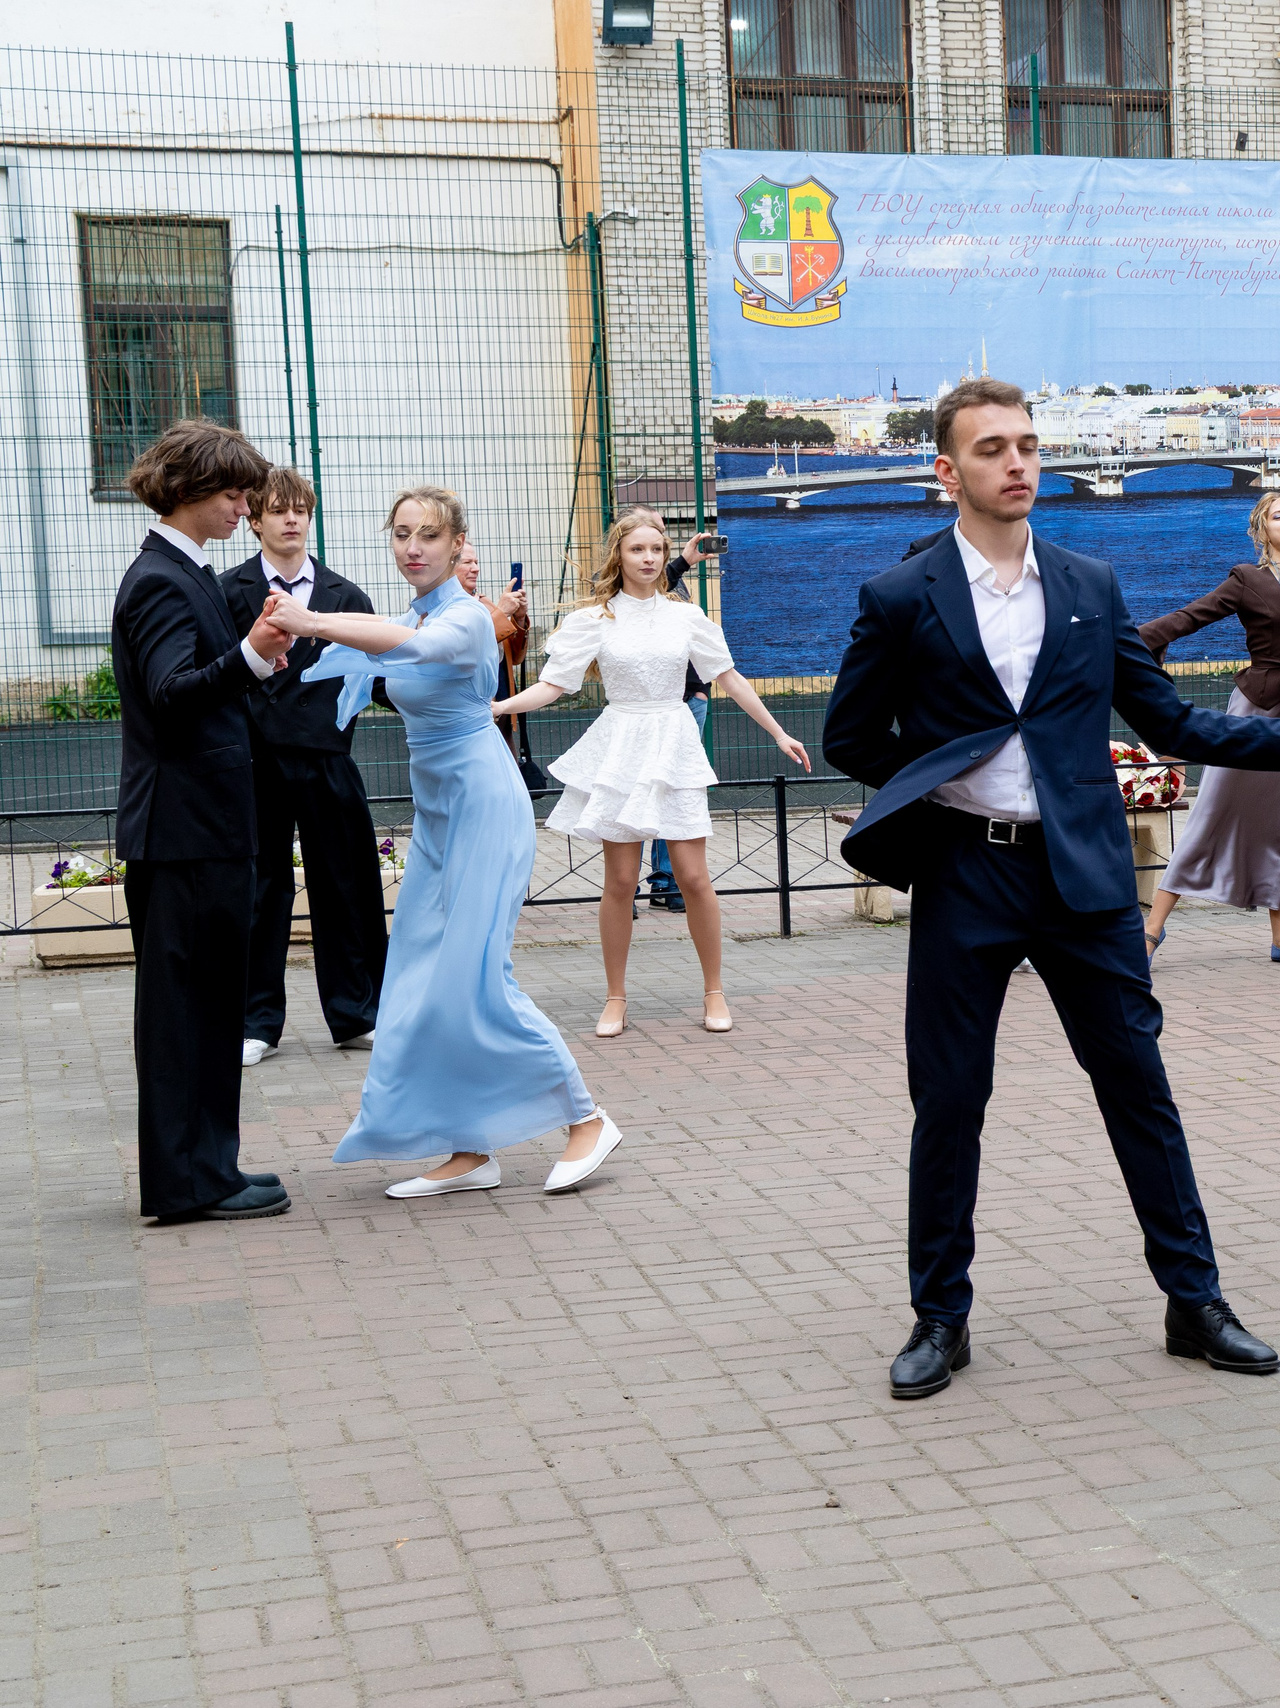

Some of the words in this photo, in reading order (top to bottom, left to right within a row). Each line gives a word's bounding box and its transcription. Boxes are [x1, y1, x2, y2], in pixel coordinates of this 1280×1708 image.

[856, 193, 924, 225] ГБОУ
[929, 202, 1003, 229] средняя
[1010, 190, 1210, 231] общеобразовательная
[1216, 206, 1276, 218] школа
[857, 233, 867, 245] с
[866, 222, 1003, 258] углубленным
[1008, 234, 1105, 260] изучением
[1109, 236, 1228, 265] литературы,
[858, 255, 1039, 296] Василеостровского
[1037, 262, 1110, 295] района
